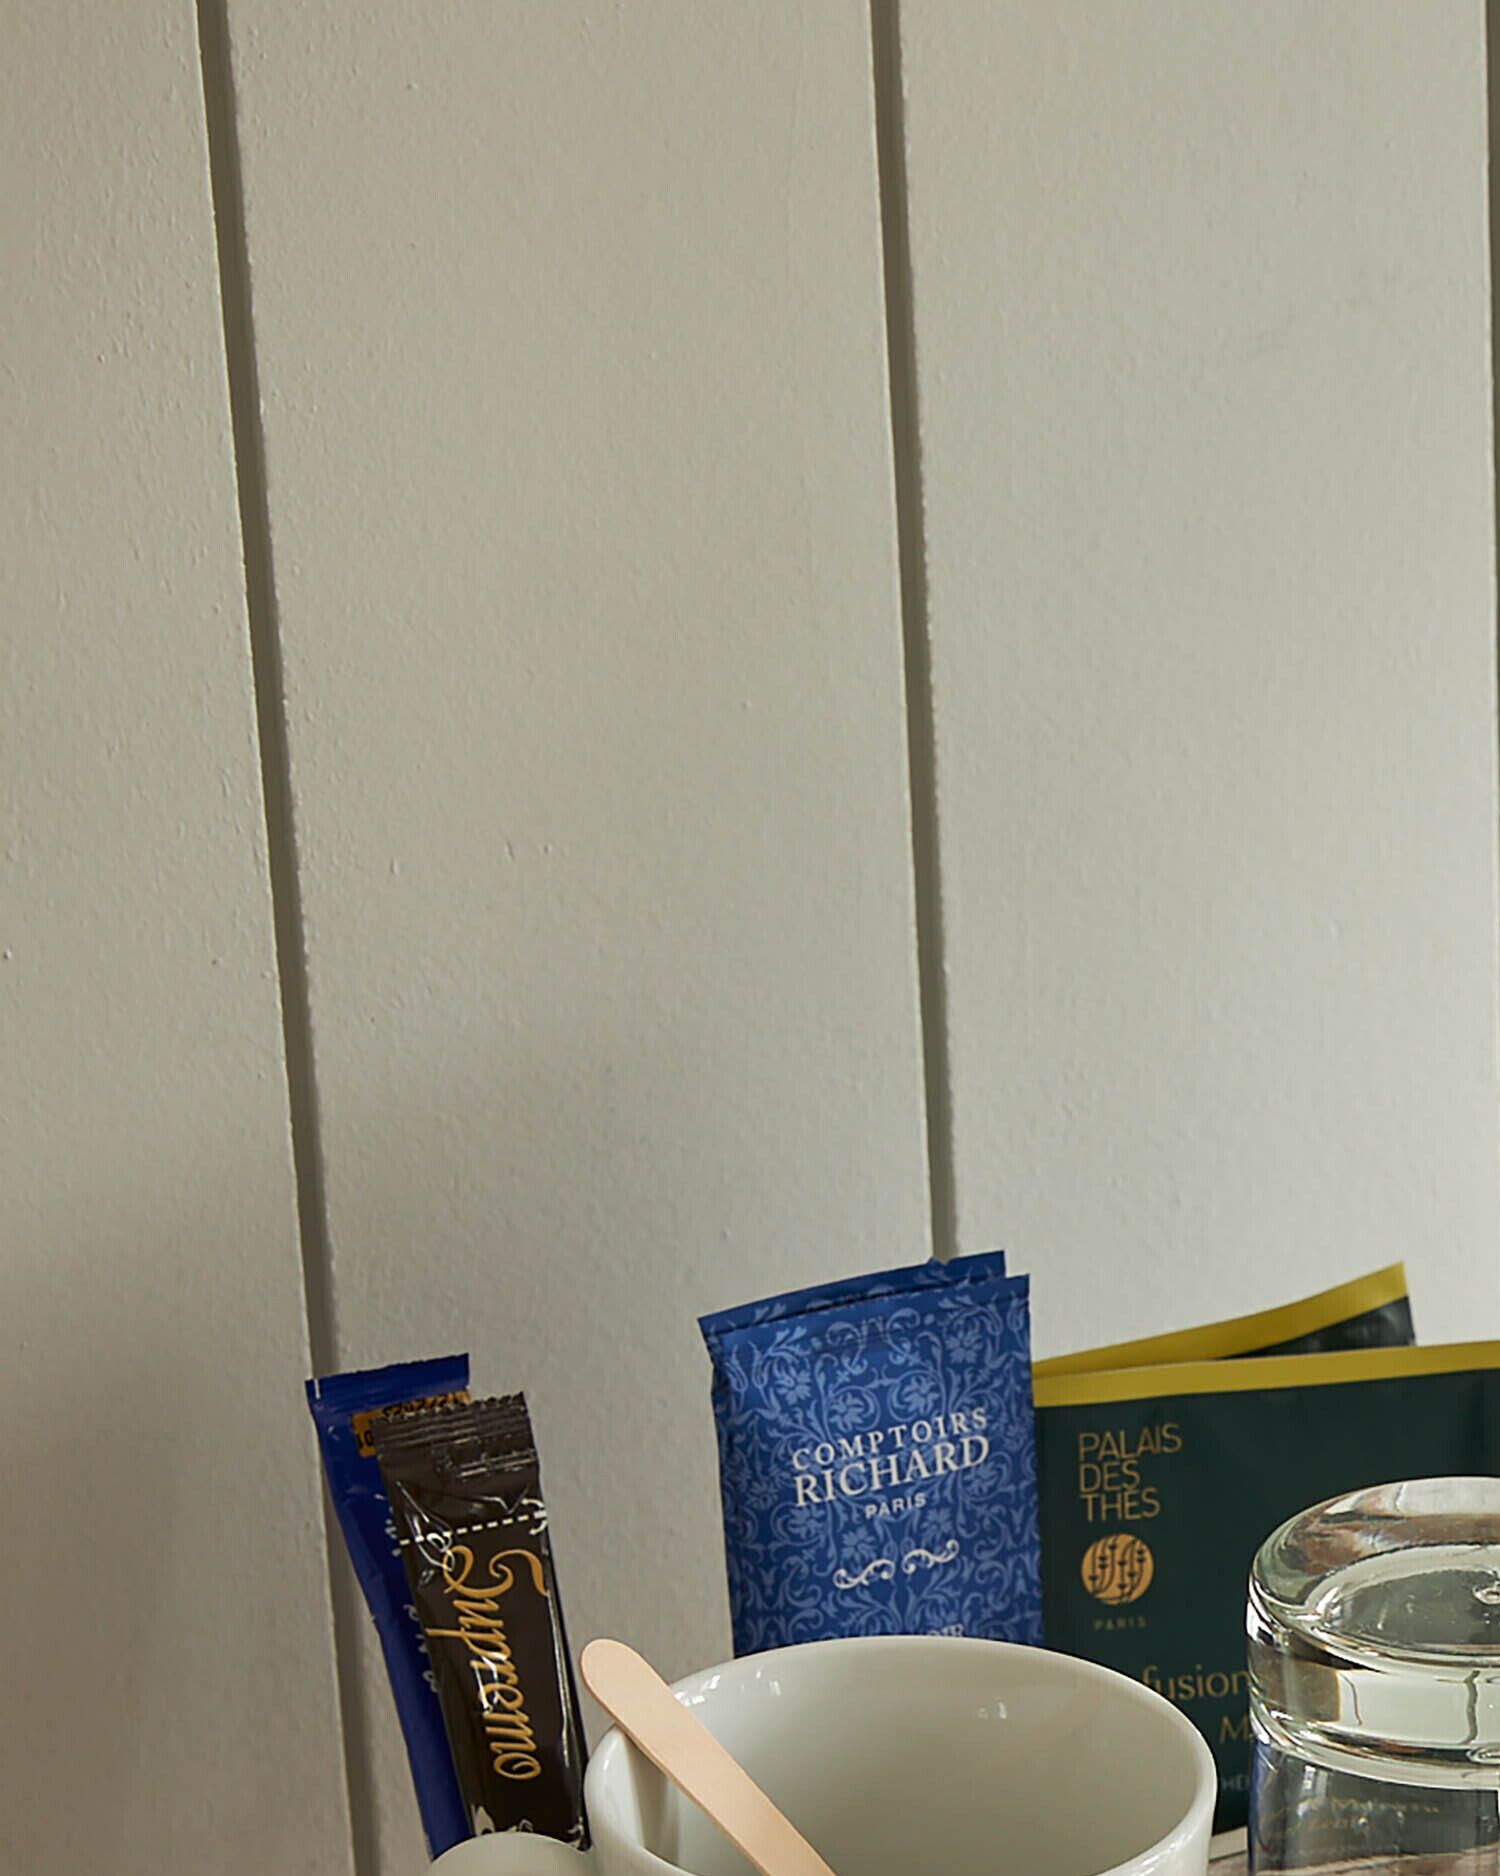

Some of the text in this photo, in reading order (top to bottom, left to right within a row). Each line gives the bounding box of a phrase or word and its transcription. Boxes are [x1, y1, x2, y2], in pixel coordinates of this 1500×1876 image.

[792, 1408, 988, 1470] COMPTOIRS
[1078, 1423, 1183, 1462] PALAIS
[795, 1435, 990, 1506] RICHARD
[1079, 1460, 1141, 1493] DES
[865, 1492, 926, 1519] PARIS
[1094, 1616, 1147, 1631] PARIS
[426, 1545, 549, 1781] Supremo
